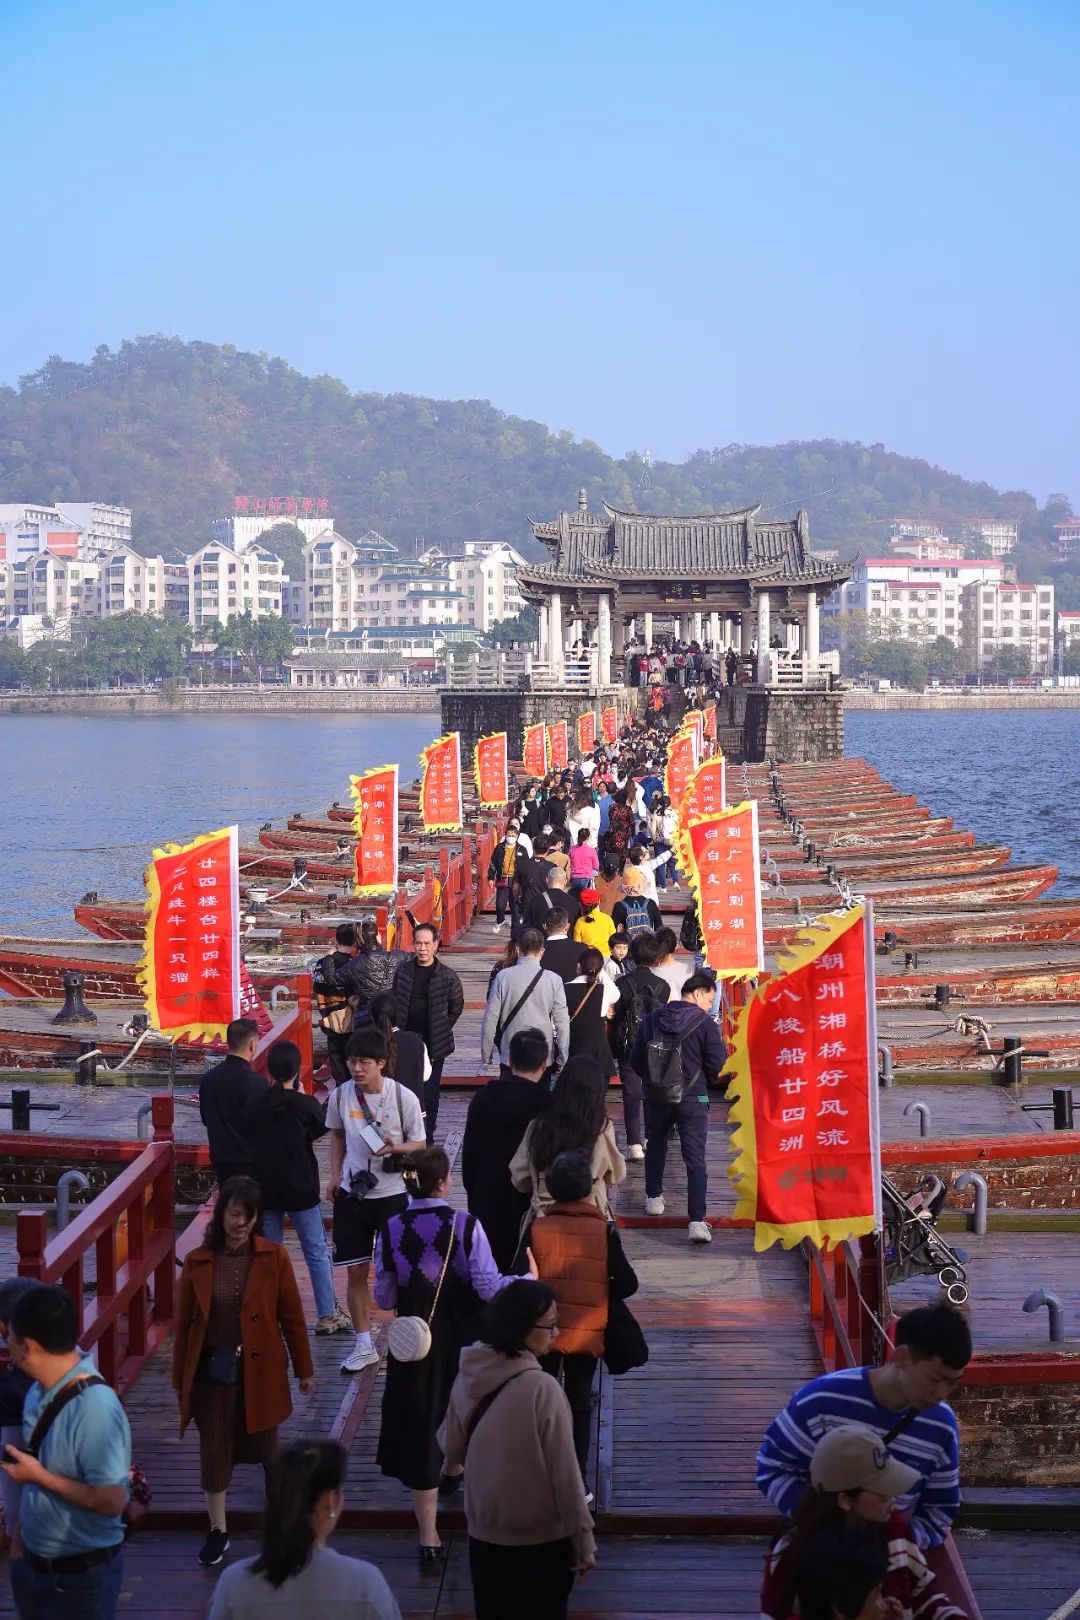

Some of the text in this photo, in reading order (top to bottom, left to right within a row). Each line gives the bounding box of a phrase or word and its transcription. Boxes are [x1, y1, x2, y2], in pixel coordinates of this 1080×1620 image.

[197, 857, 220, 979] 廿四楼台廿四样
[705, 828, 723, 930] 白白走一场
[726, 826, 745, 929] 到广不到潮
[771, 988, 808, 1152] 八梭船廿四洲
[813, 952, 850, 1147] 潮州湘桥好风流
